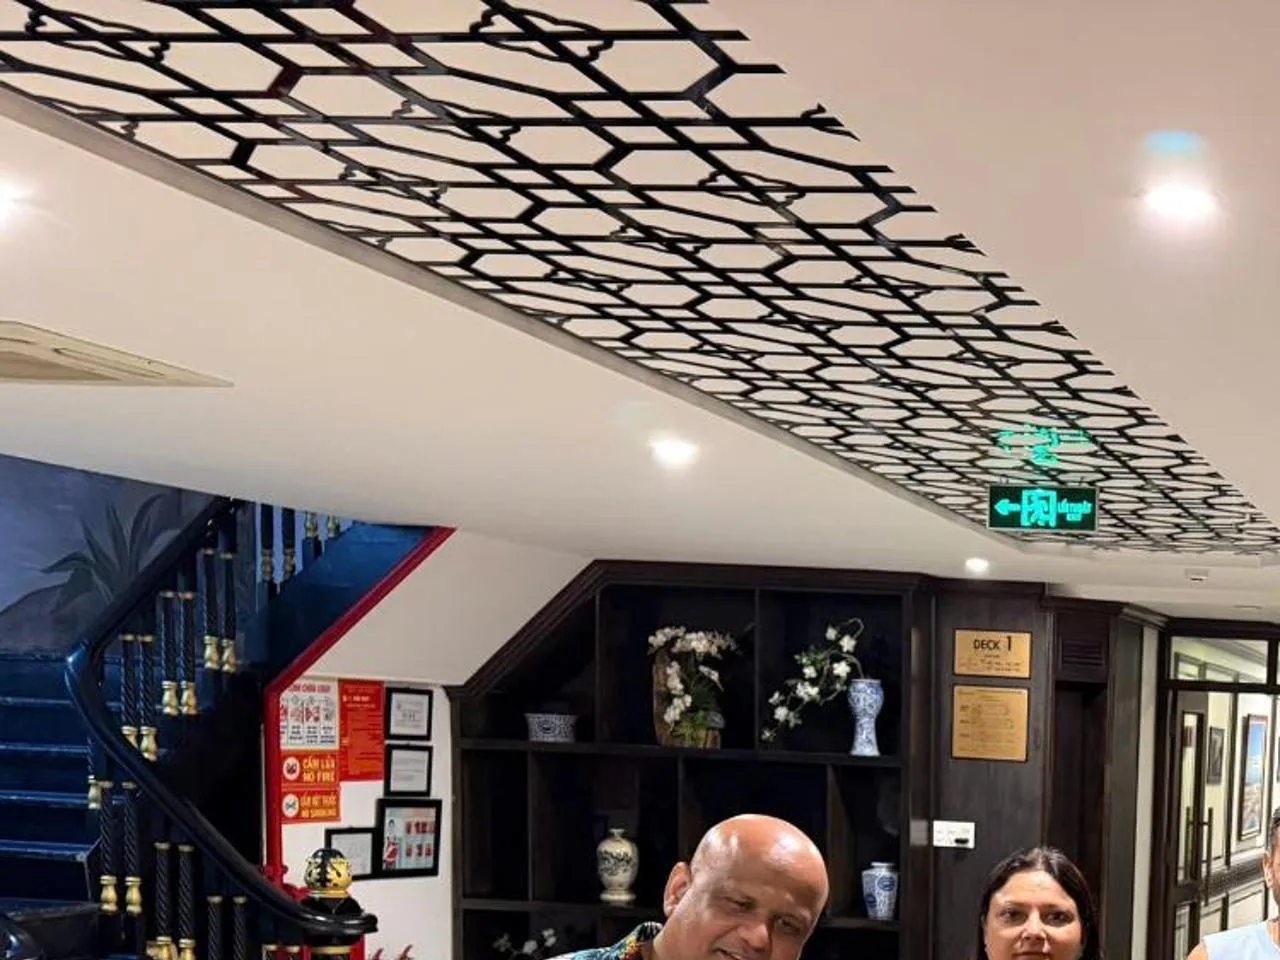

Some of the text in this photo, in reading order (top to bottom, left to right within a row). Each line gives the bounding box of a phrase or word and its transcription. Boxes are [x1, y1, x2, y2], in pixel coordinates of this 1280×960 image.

[973, 635, 1012, 652] DECK 1
[303, 771, 336, 783] NO FIRE
